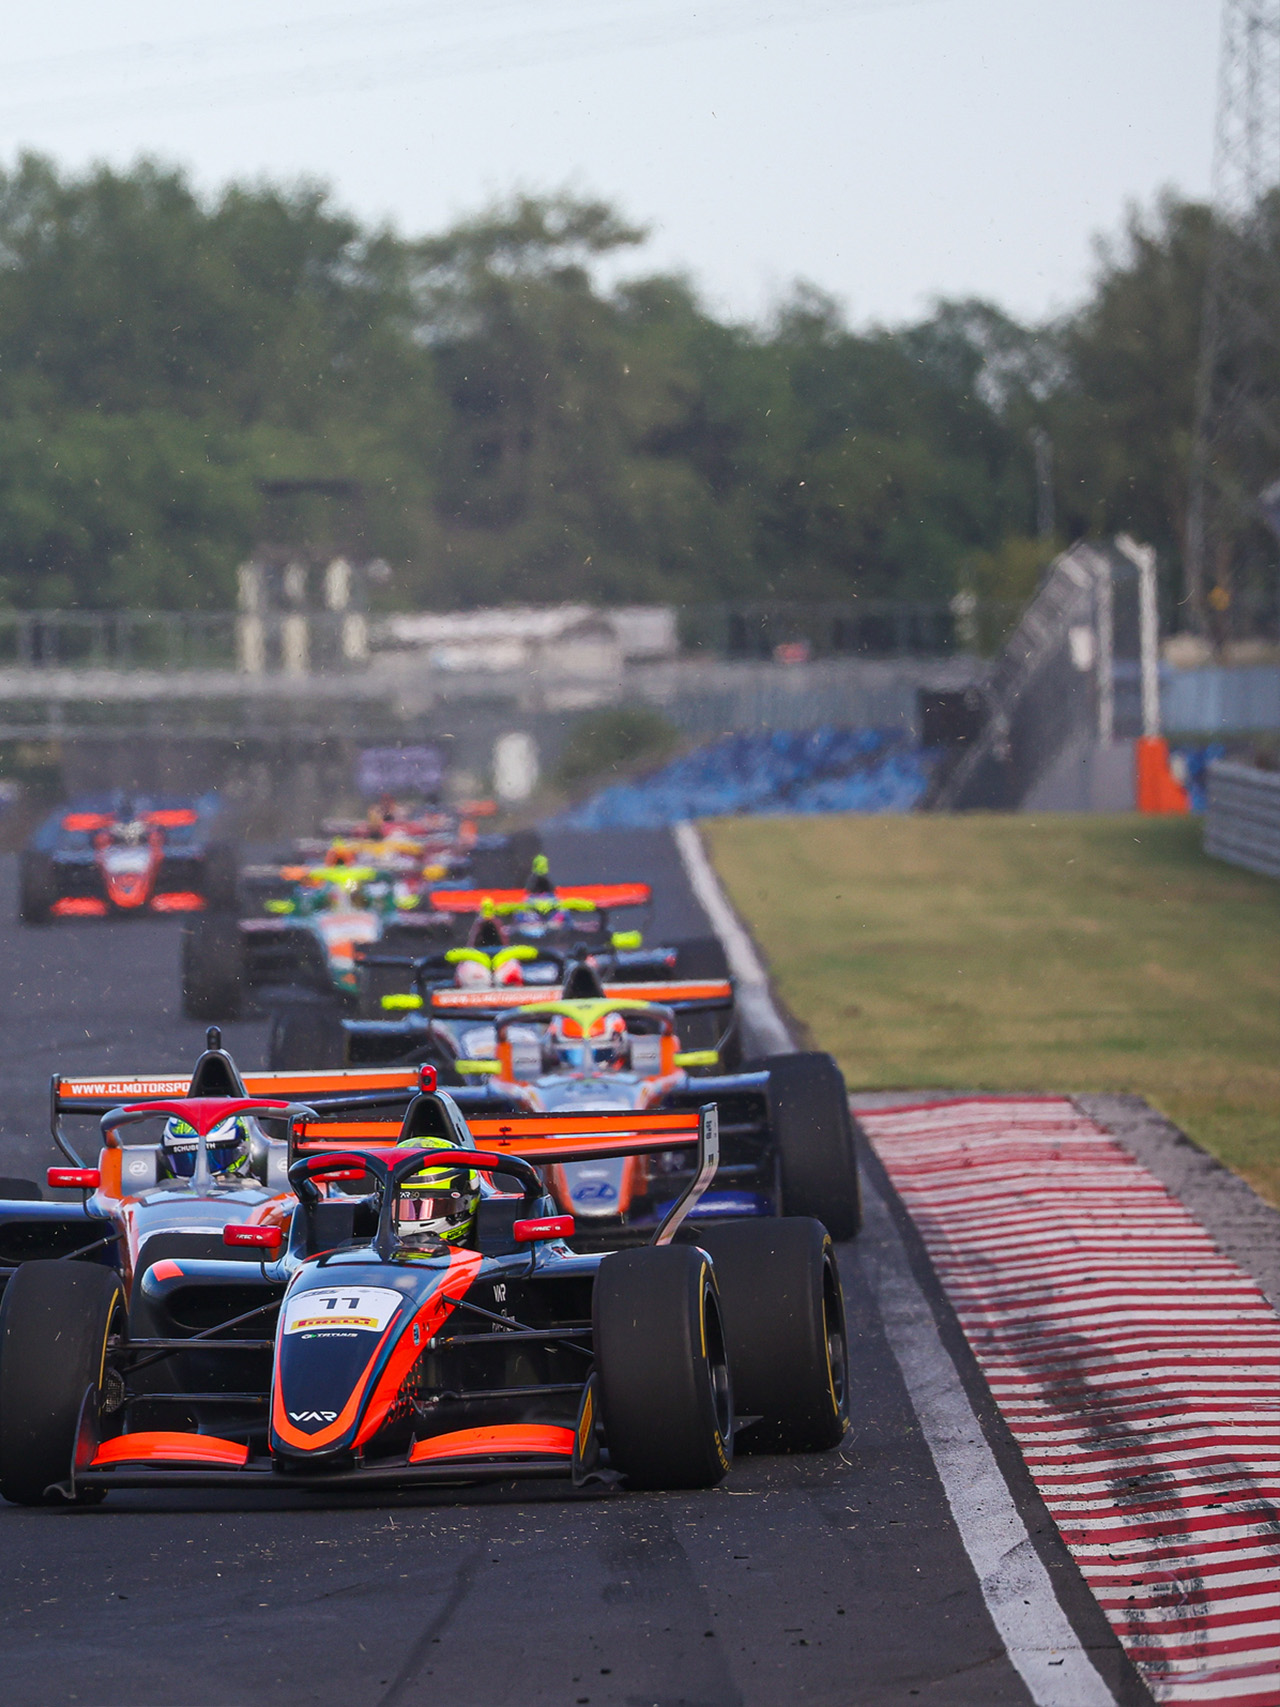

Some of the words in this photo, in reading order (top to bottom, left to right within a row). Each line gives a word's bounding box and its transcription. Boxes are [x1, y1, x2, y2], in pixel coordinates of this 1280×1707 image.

[319, 1297, 361, 1310] 11
[298, 1317, 371, 1327] PIRELLI
[289, 1411, 338, 1422] VAR
